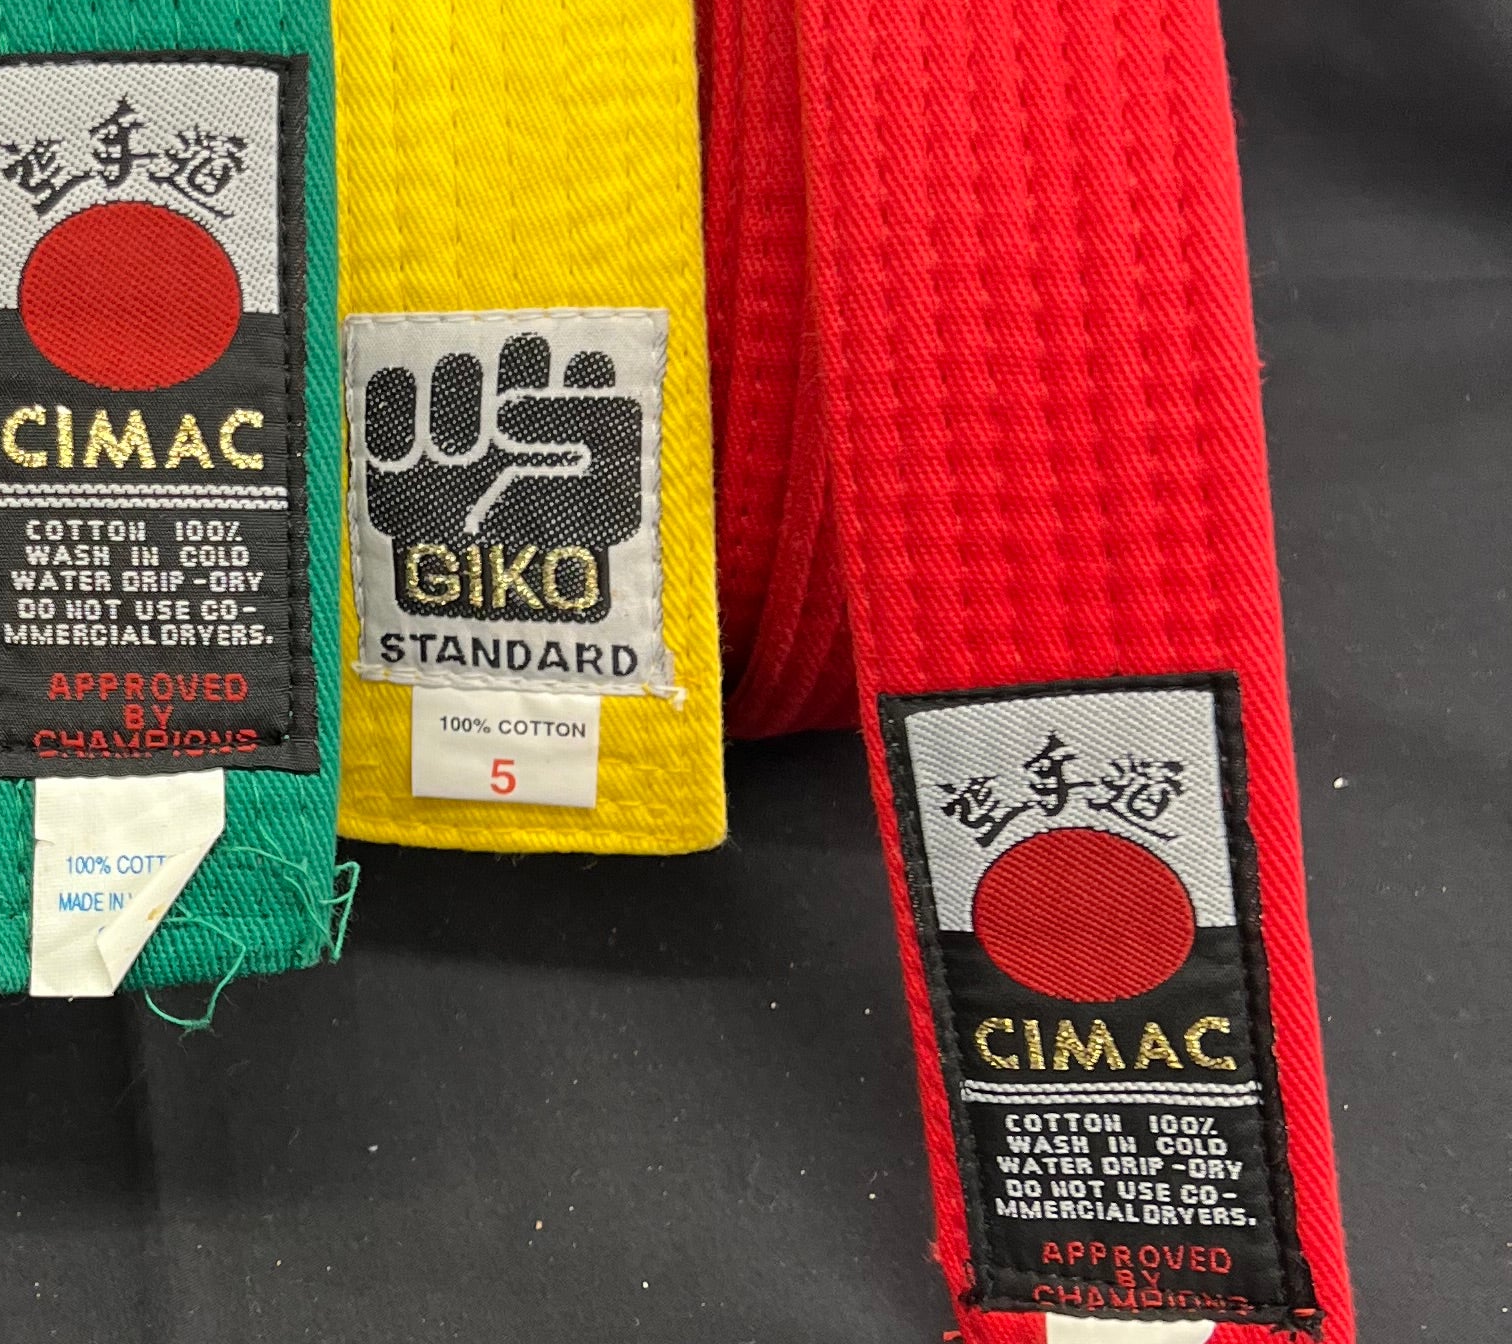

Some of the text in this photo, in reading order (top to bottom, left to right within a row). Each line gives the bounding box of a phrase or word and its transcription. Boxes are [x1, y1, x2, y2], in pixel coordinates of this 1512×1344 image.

[1, 404, 265, 470] CIMAC
[25, 520, 243, 541] COTTON 100%
[25, 545, 250, 567] WASH IN COLD
[10, 570, 112, 592] WATER
[405, 543, 599, 609] GIKO
[16, 598, 56, 620] DO
[65, 599, 122, 620] NOT
[135, 600, 191, 621] USE
[379, 633, 638, 676] STANDARD
[48, 672, 248, 702] APPROVED
[123, 704, 174, 730] BY
[439, 716, 586, 738] 100% COTTON
[490, 758, 516, 795] 5
[66, 854, 167, 874] 100% COTT
[59, 892, 104, 912] MADE
[109, 892, 124, 911] IN
[974, 1016, 1237, 1071] CIMAC
[1004, 1112, 1218, 1136] COTTON 100%
[1007, 1136, 1228, 1156] WASH IN COLD
[996, 1157, 1093, 1175] WATER
[1006, 1179, 1042, 1198] DO
[1051, 1180, 1105, 1199] NOT
[1118, 1181, 1171, 1202] USE
[1042, 1240, 1232, 1274] APPROVED
[1115, 1269, 1160, 1289] BY
